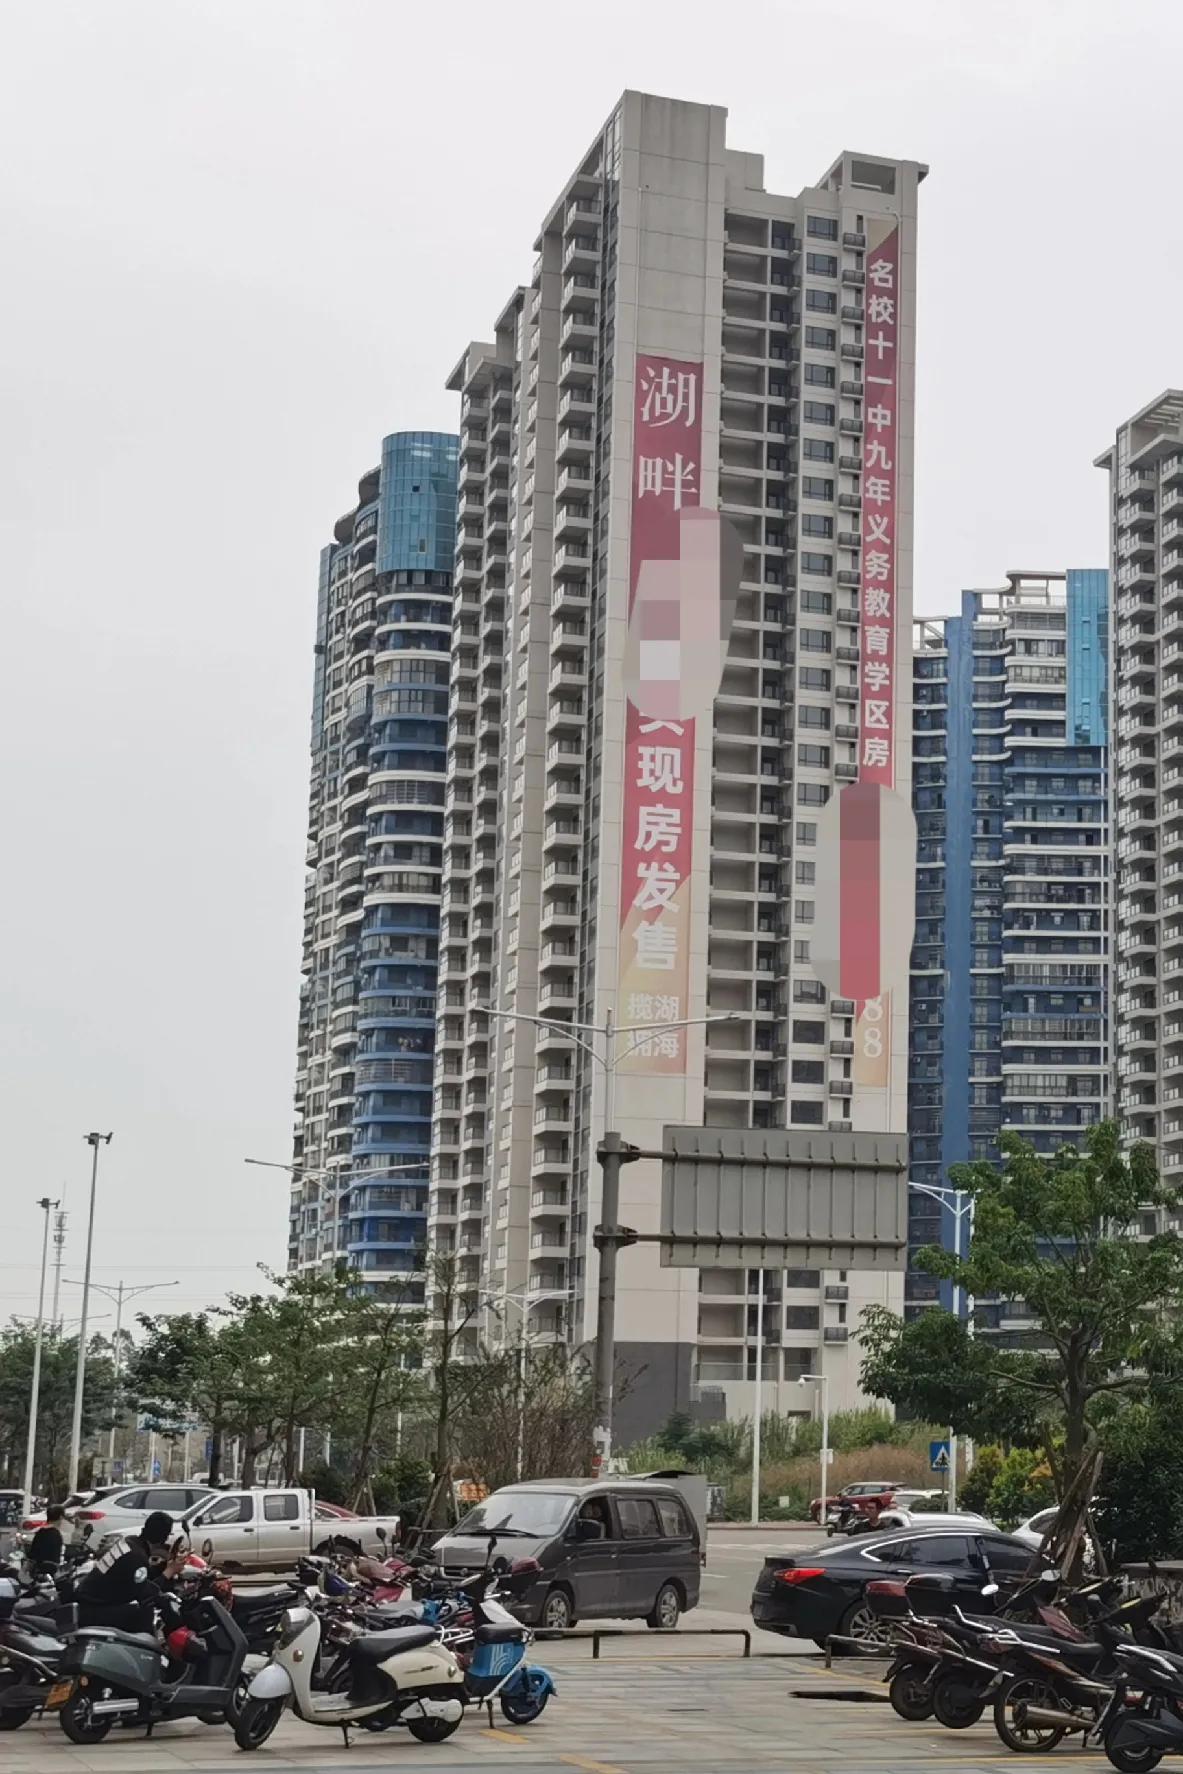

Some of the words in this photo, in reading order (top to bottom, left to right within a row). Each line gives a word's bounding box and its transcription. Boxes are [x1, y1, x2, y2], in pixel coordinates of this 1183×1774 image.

[638, 366, 699, 511] 湖畔
[863, 259, 895, 768] 名校十一中九年义务教育学区房
